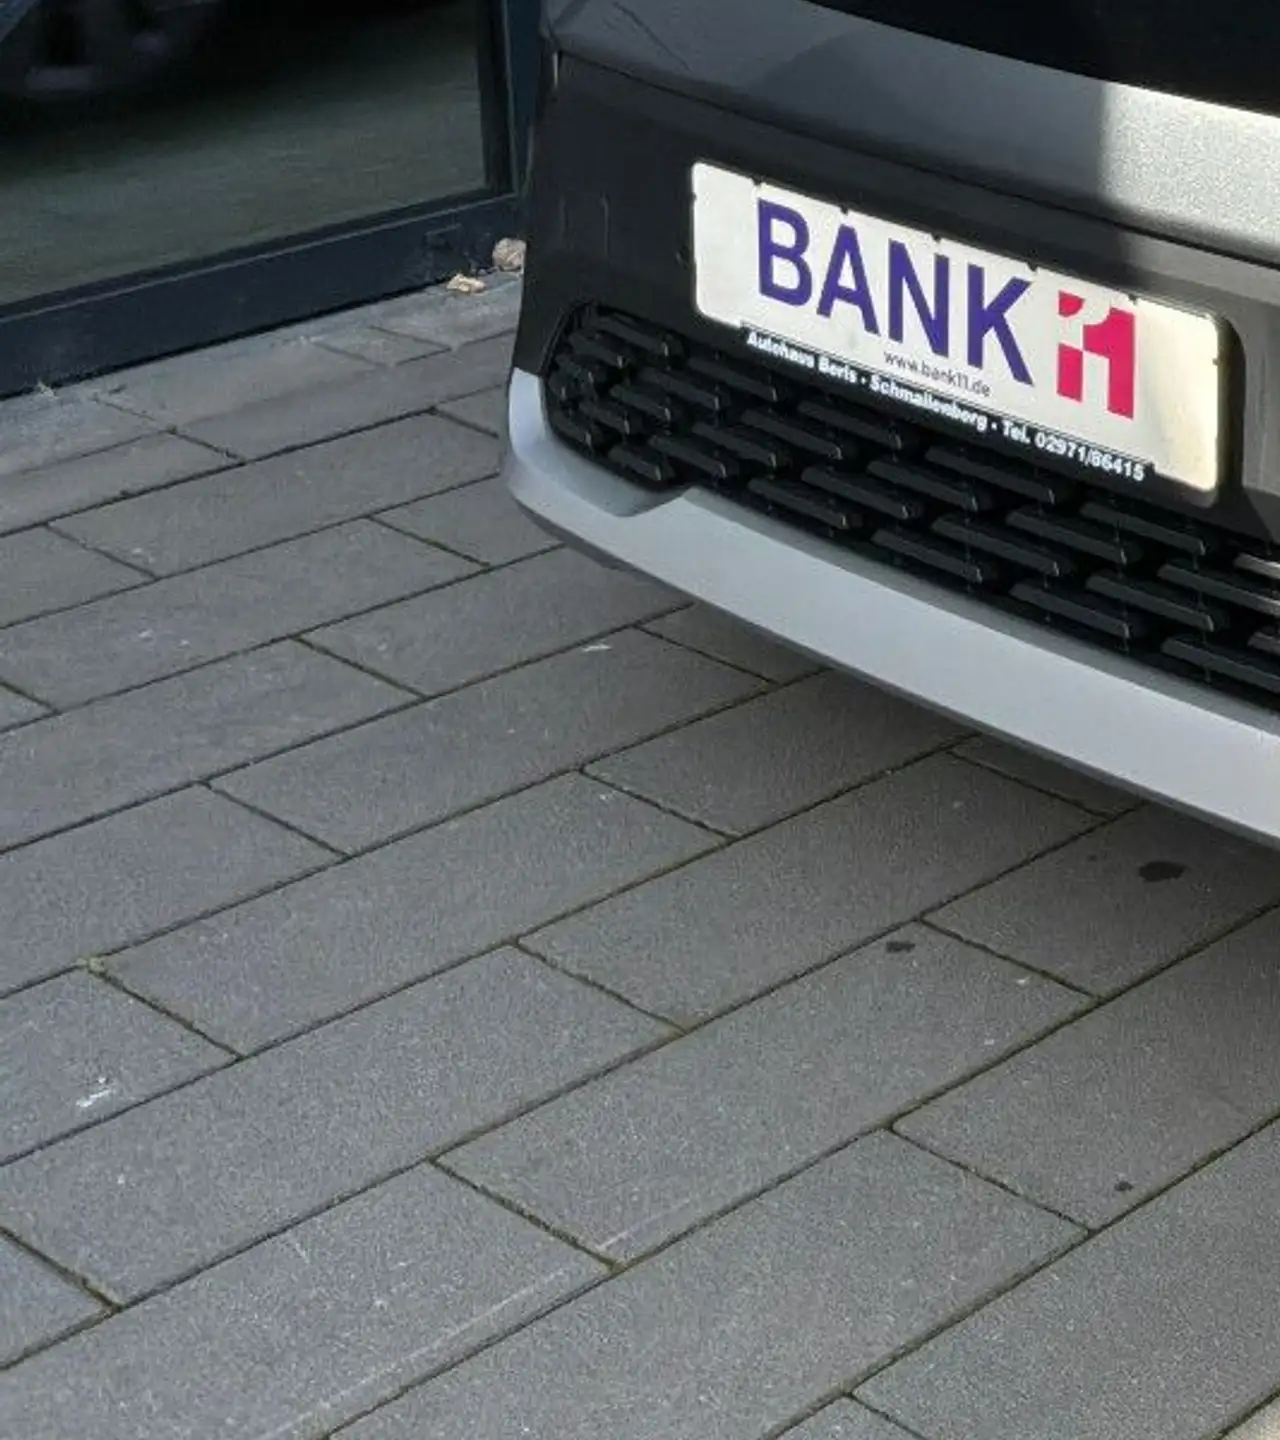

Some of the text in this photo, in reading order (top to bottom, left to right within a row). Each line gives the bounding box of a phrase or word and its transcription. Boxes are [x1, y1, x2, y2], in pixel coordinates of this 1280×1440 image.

[757, 198, 1034, 387] BANK
[746, 331, 815, 369] Autohaus
[883, 350, 990, 398] www.bank11.de
